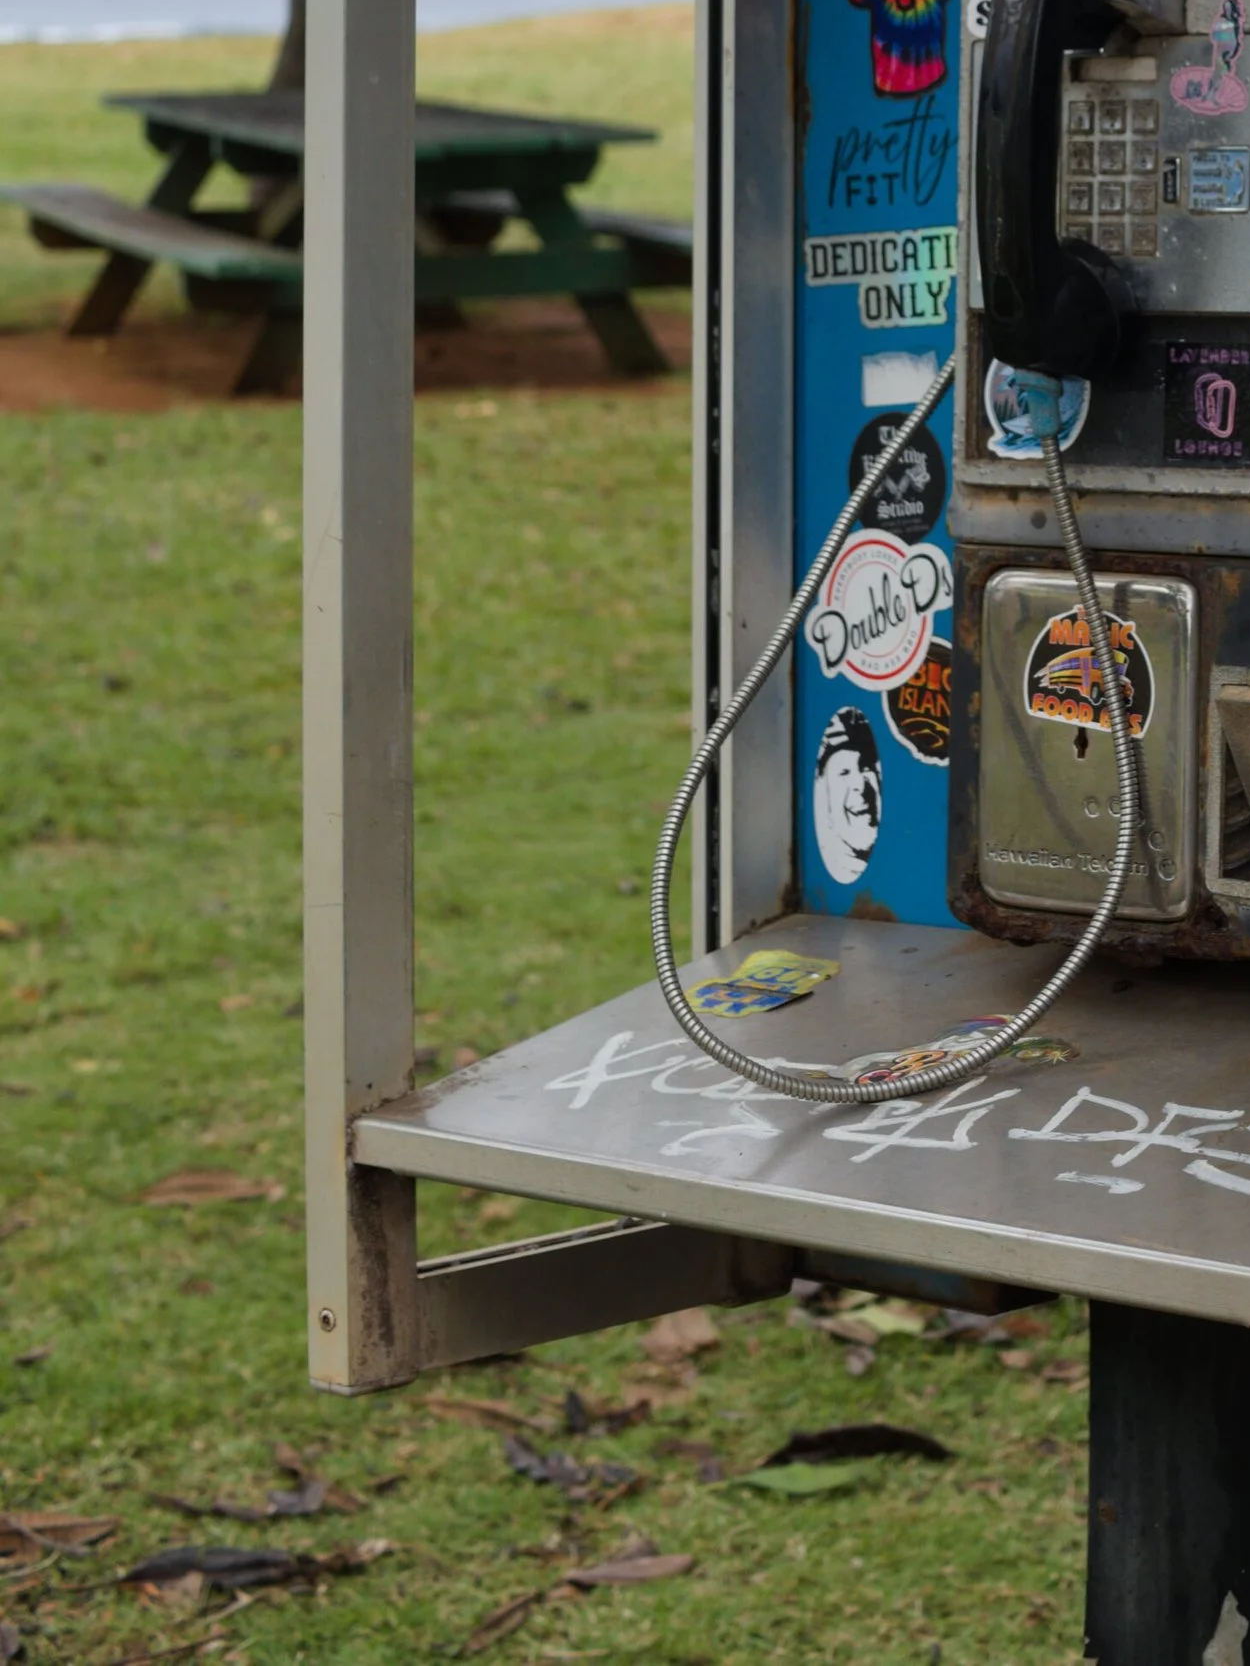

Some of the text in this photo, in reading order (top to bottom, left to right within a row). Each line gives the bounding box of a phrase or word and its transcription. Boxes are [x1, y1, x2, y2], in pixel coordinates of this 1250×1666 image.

[845, 173, 899, 209] FIT
[810, 234, 957, 280] DEDICATI
[865, 282, 945, 320] ONLY
[1169, 346, 1250, 366] LAVENDER
[1175, 439, 1243, 458] LOUNGE
[811, 572, 907, 669] Double
[1049, 619, 1135, 650] MAIC
[898, 688, 952, 718] ISLAN
[1031, 693, 1093, 725] FOOD
[984, 840, 1072, 871] Hawaiian
